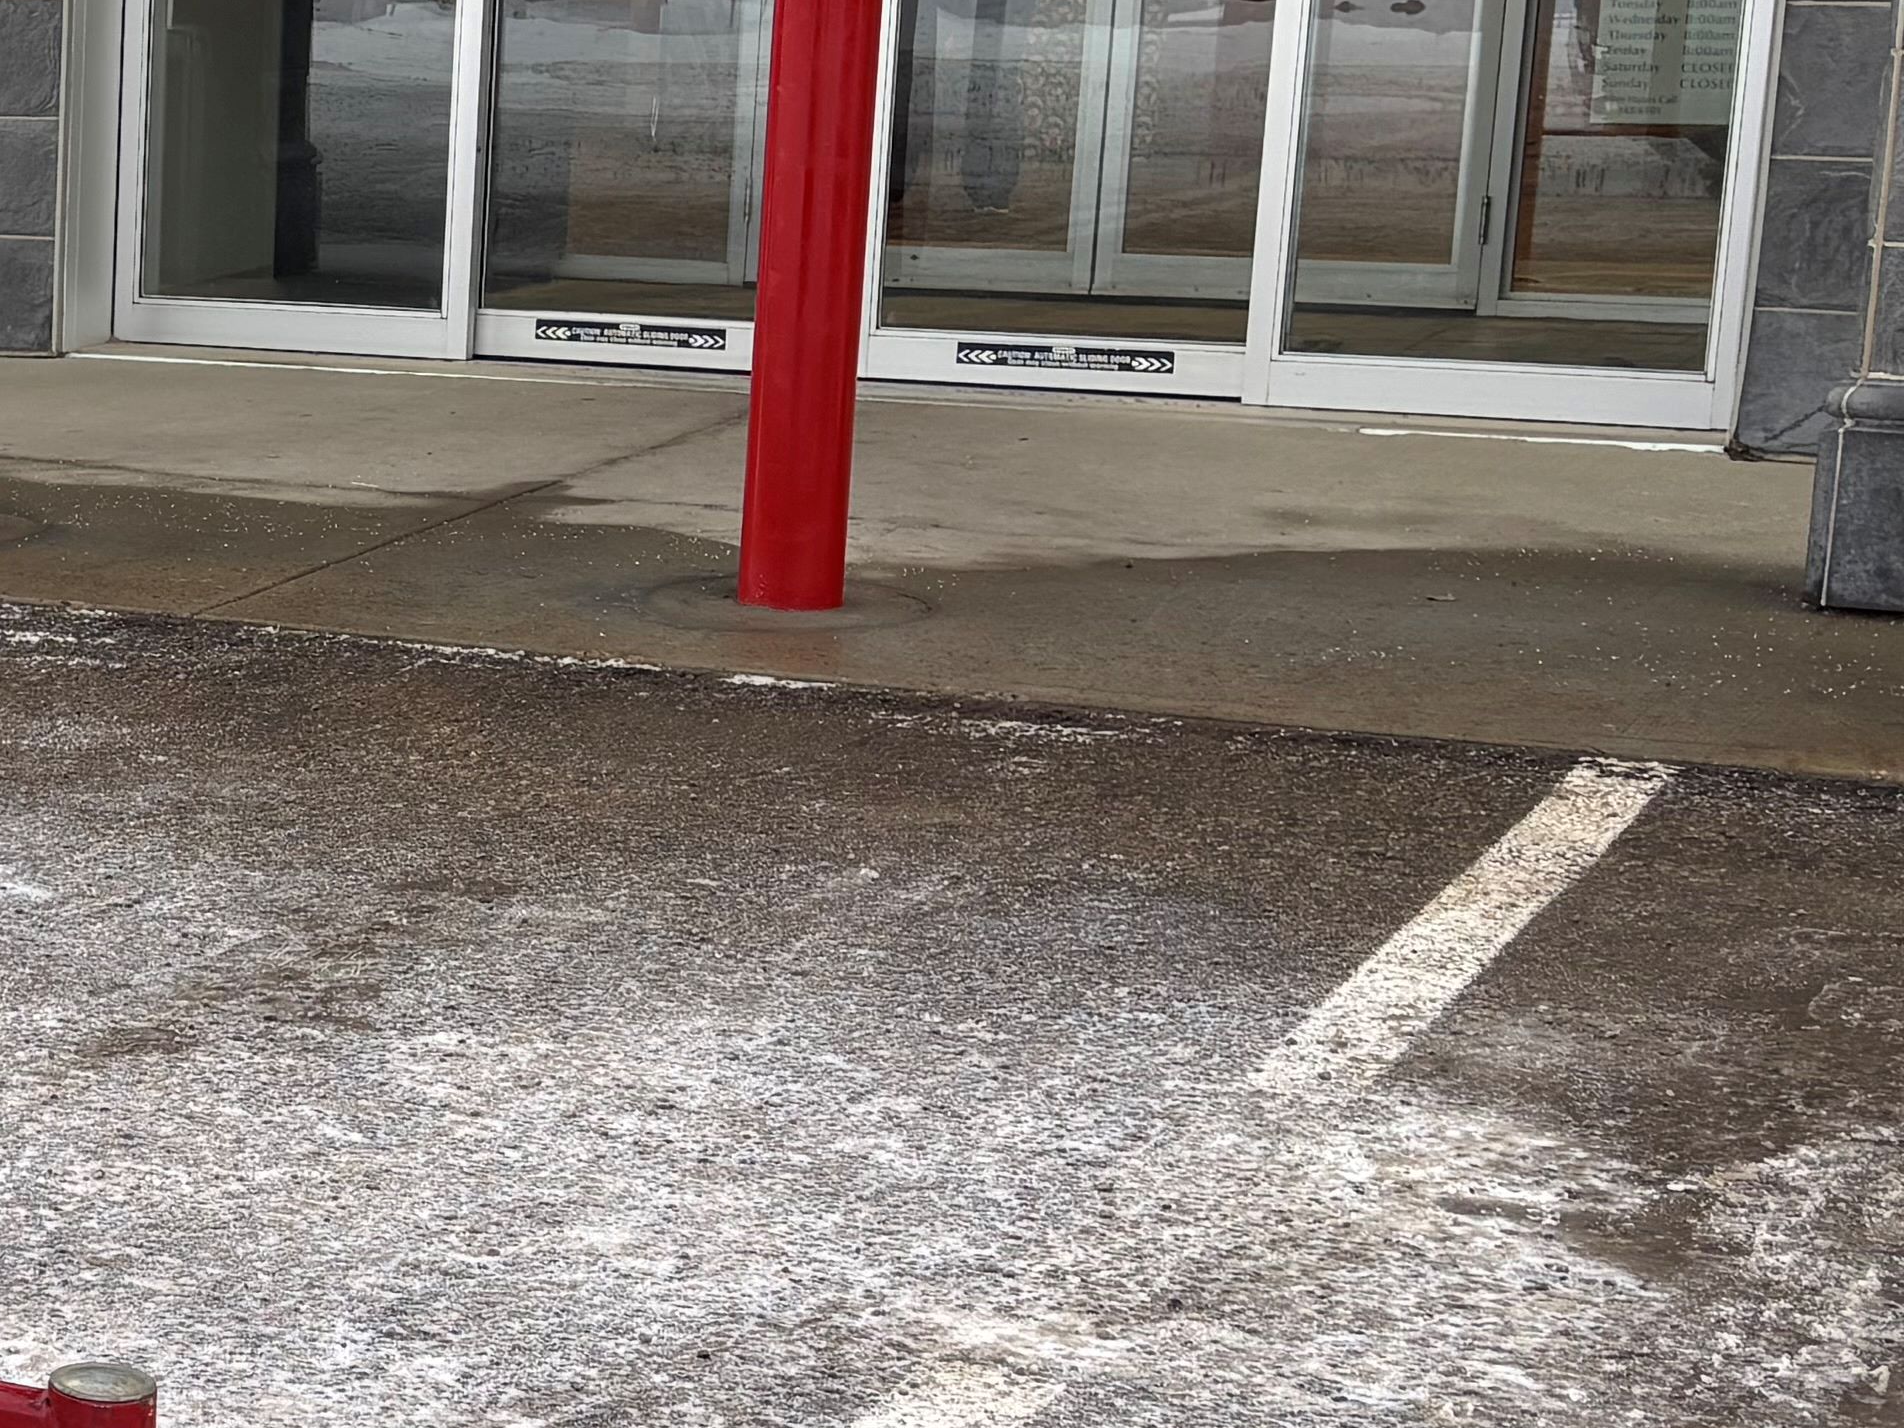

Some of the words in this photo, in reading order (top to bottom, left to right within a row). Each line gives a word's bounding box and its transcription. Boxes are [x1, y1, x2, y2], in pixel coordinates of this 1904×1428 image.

[1610, 0, 1663, 11] Tuesday
[1608, 31, 1667, 42] Thursday
[1603, 61, 1660, 73] Saturday
[1601, 77, 1648, 90] Sunday
